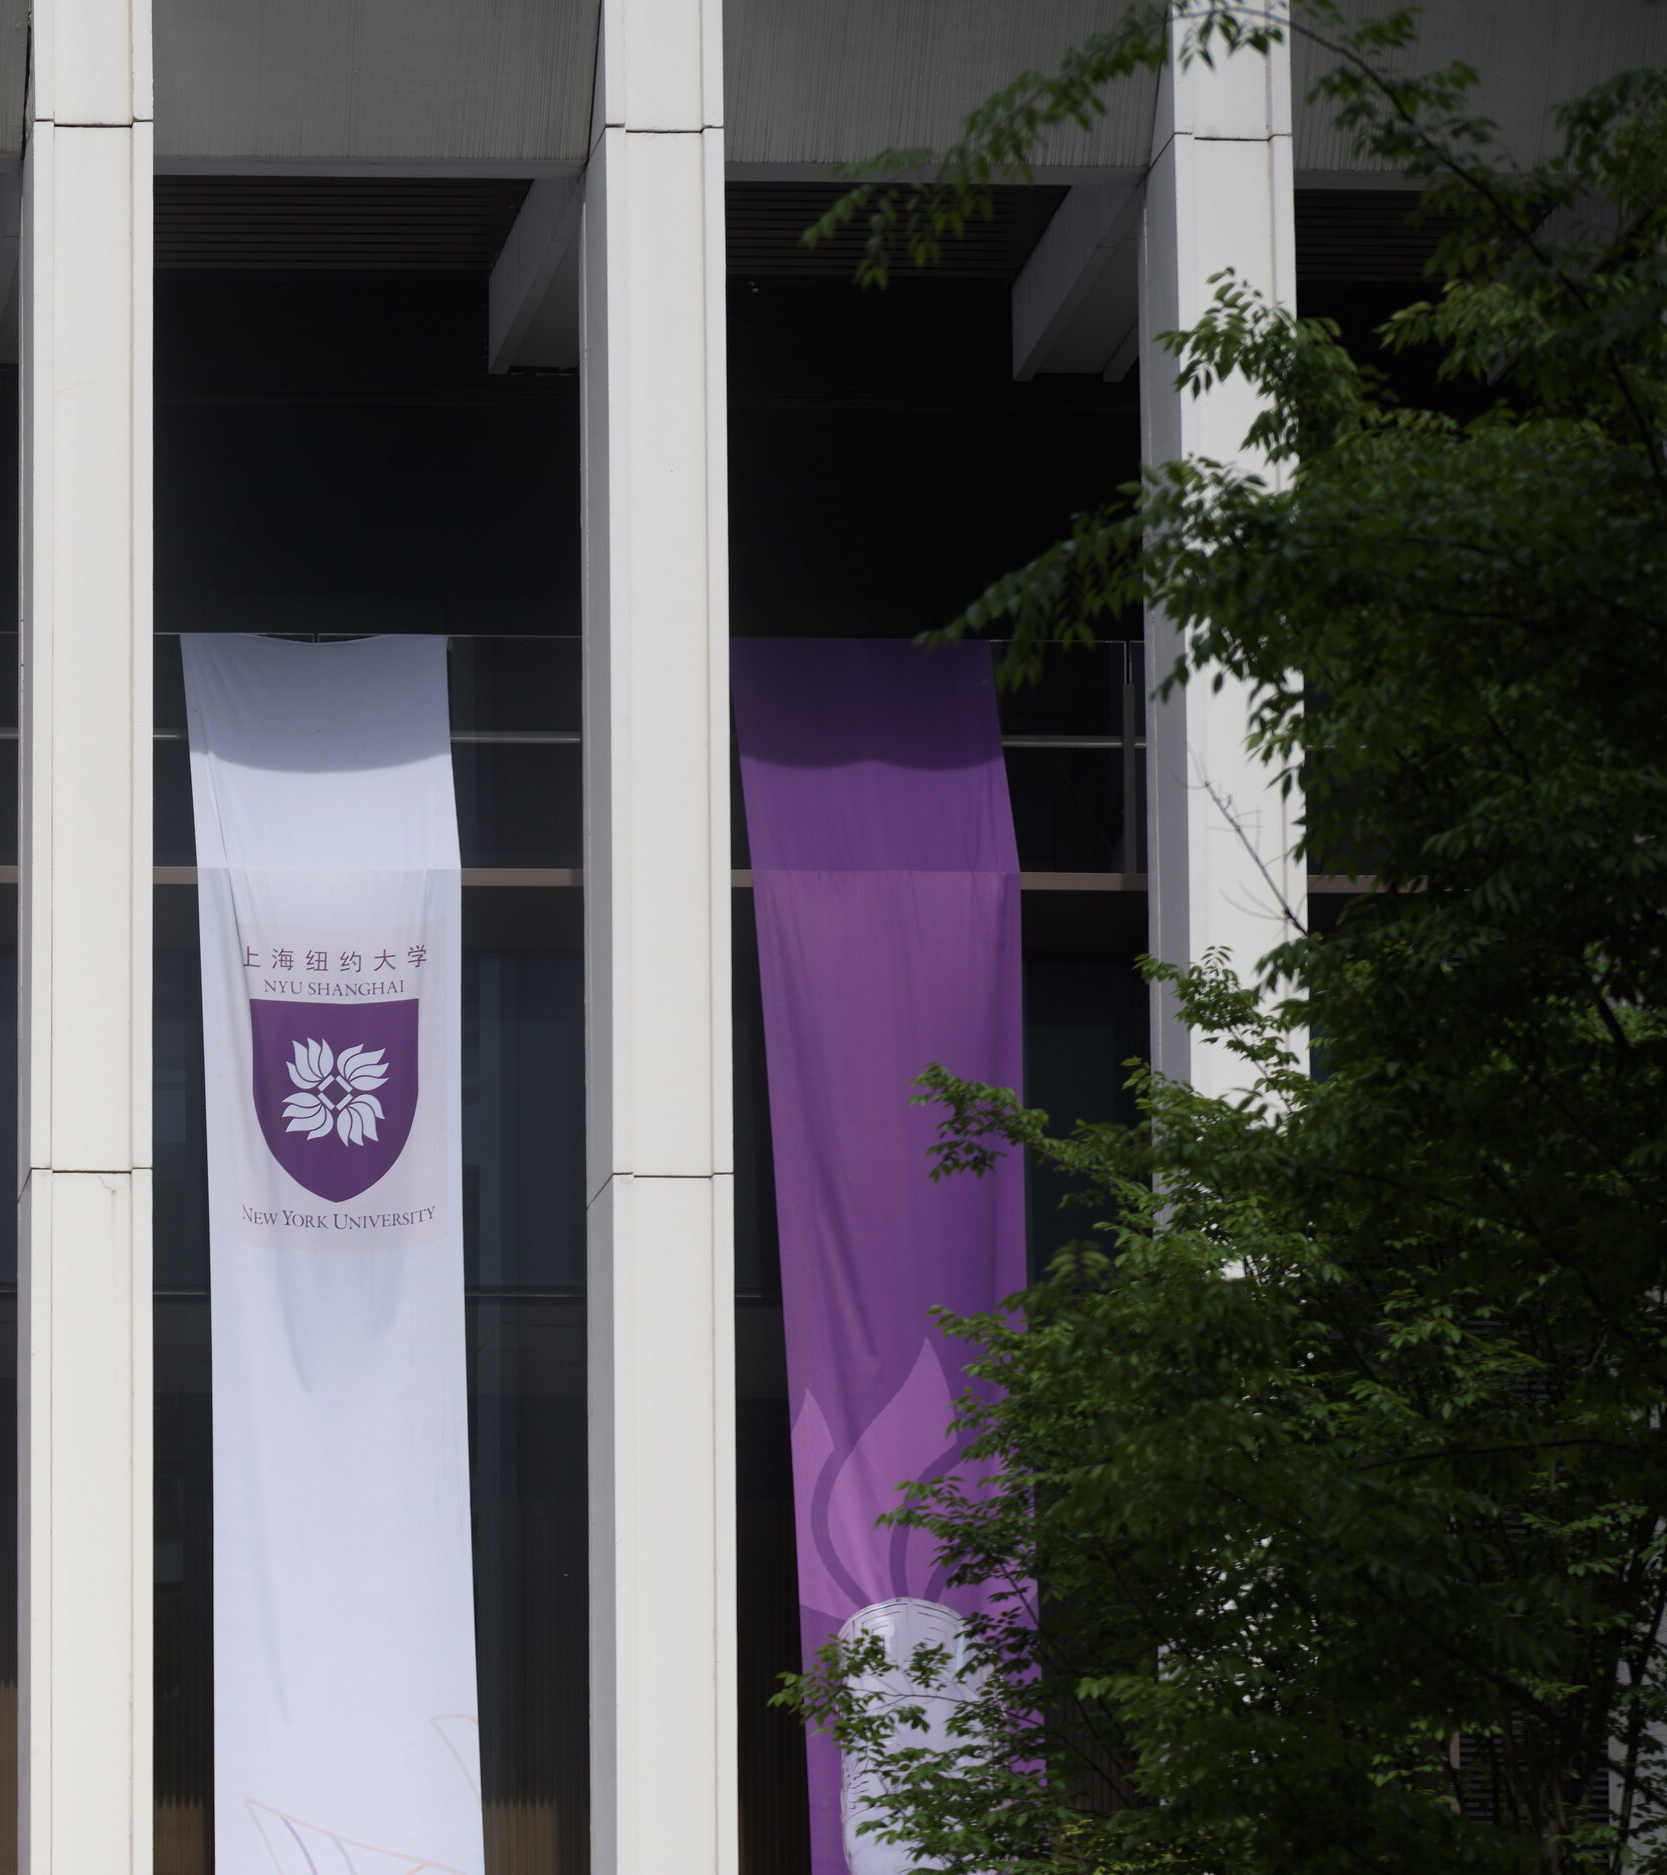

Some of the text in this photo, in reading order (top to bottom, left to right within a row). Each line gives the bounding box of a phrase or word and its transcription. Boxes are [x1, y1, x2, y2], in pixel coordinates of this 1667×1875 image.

[243, 944, 427, 973] 上海纽约大学
[263, 979, 405, 997] NYU SHANGHAI
